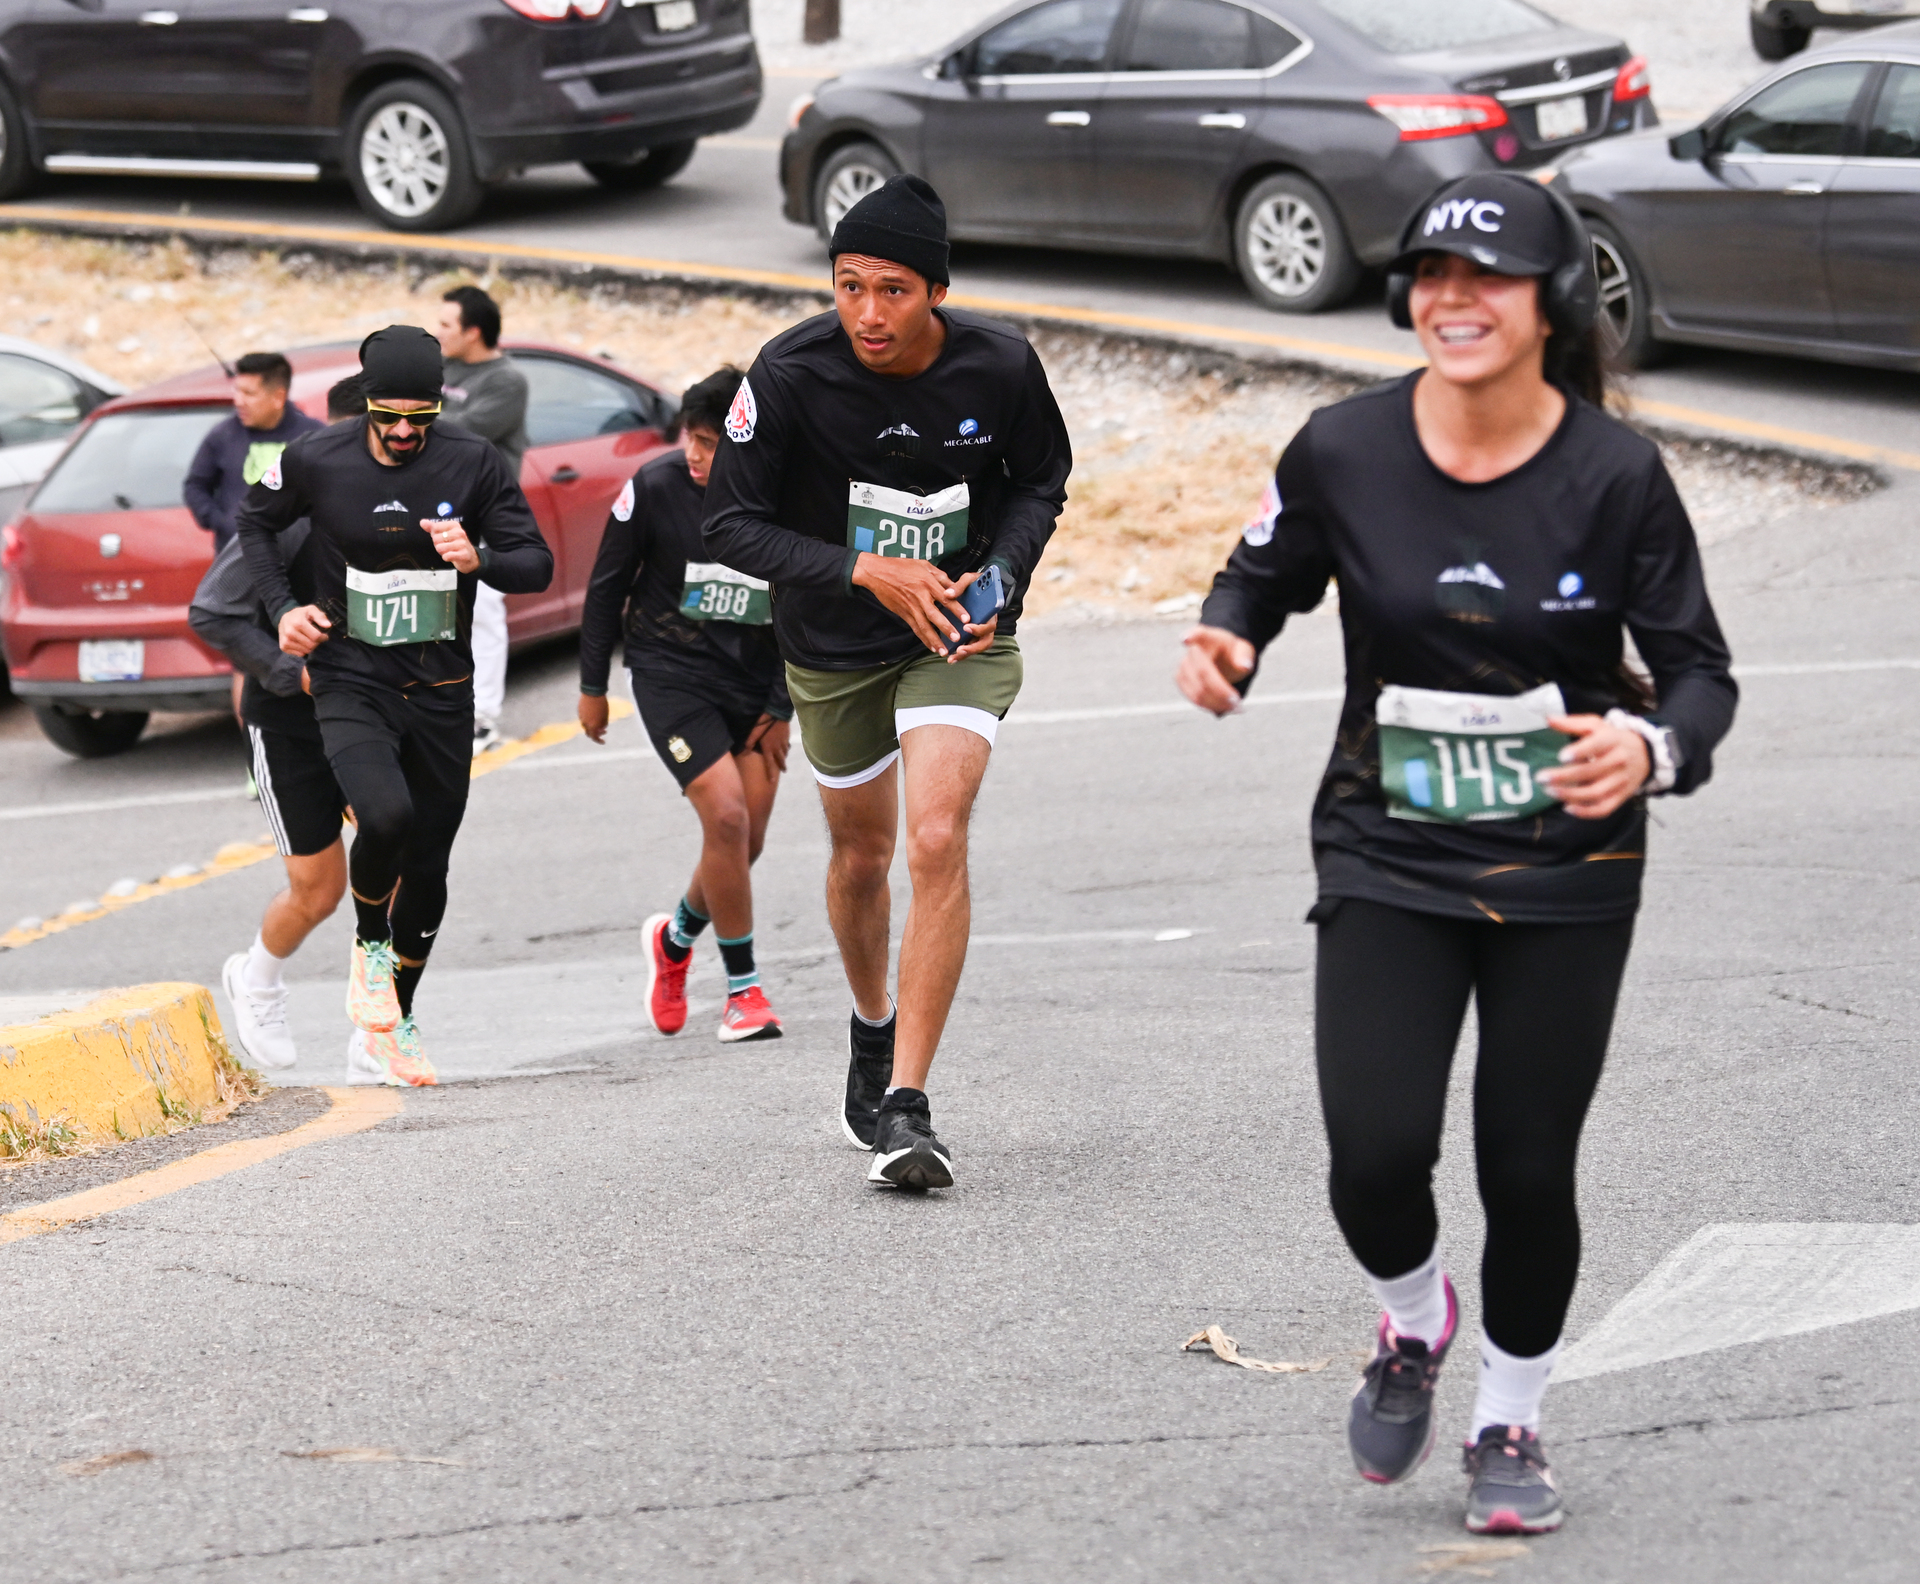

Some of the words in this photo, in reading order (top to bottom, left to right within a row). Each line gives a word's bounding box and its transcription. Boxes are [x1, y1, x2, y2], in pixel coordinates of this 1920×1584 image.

[1423, 198, 1505, 237] NYC
[943, 434, 993, 447] MEGACABLE
[906, 506, 934, 515] LALA
[877, 518, 946, 560] 298
[366, 594, 418, 637] 474
[699, 582, 750, 616] 388
[1429, 736, 1534, 809] 145
